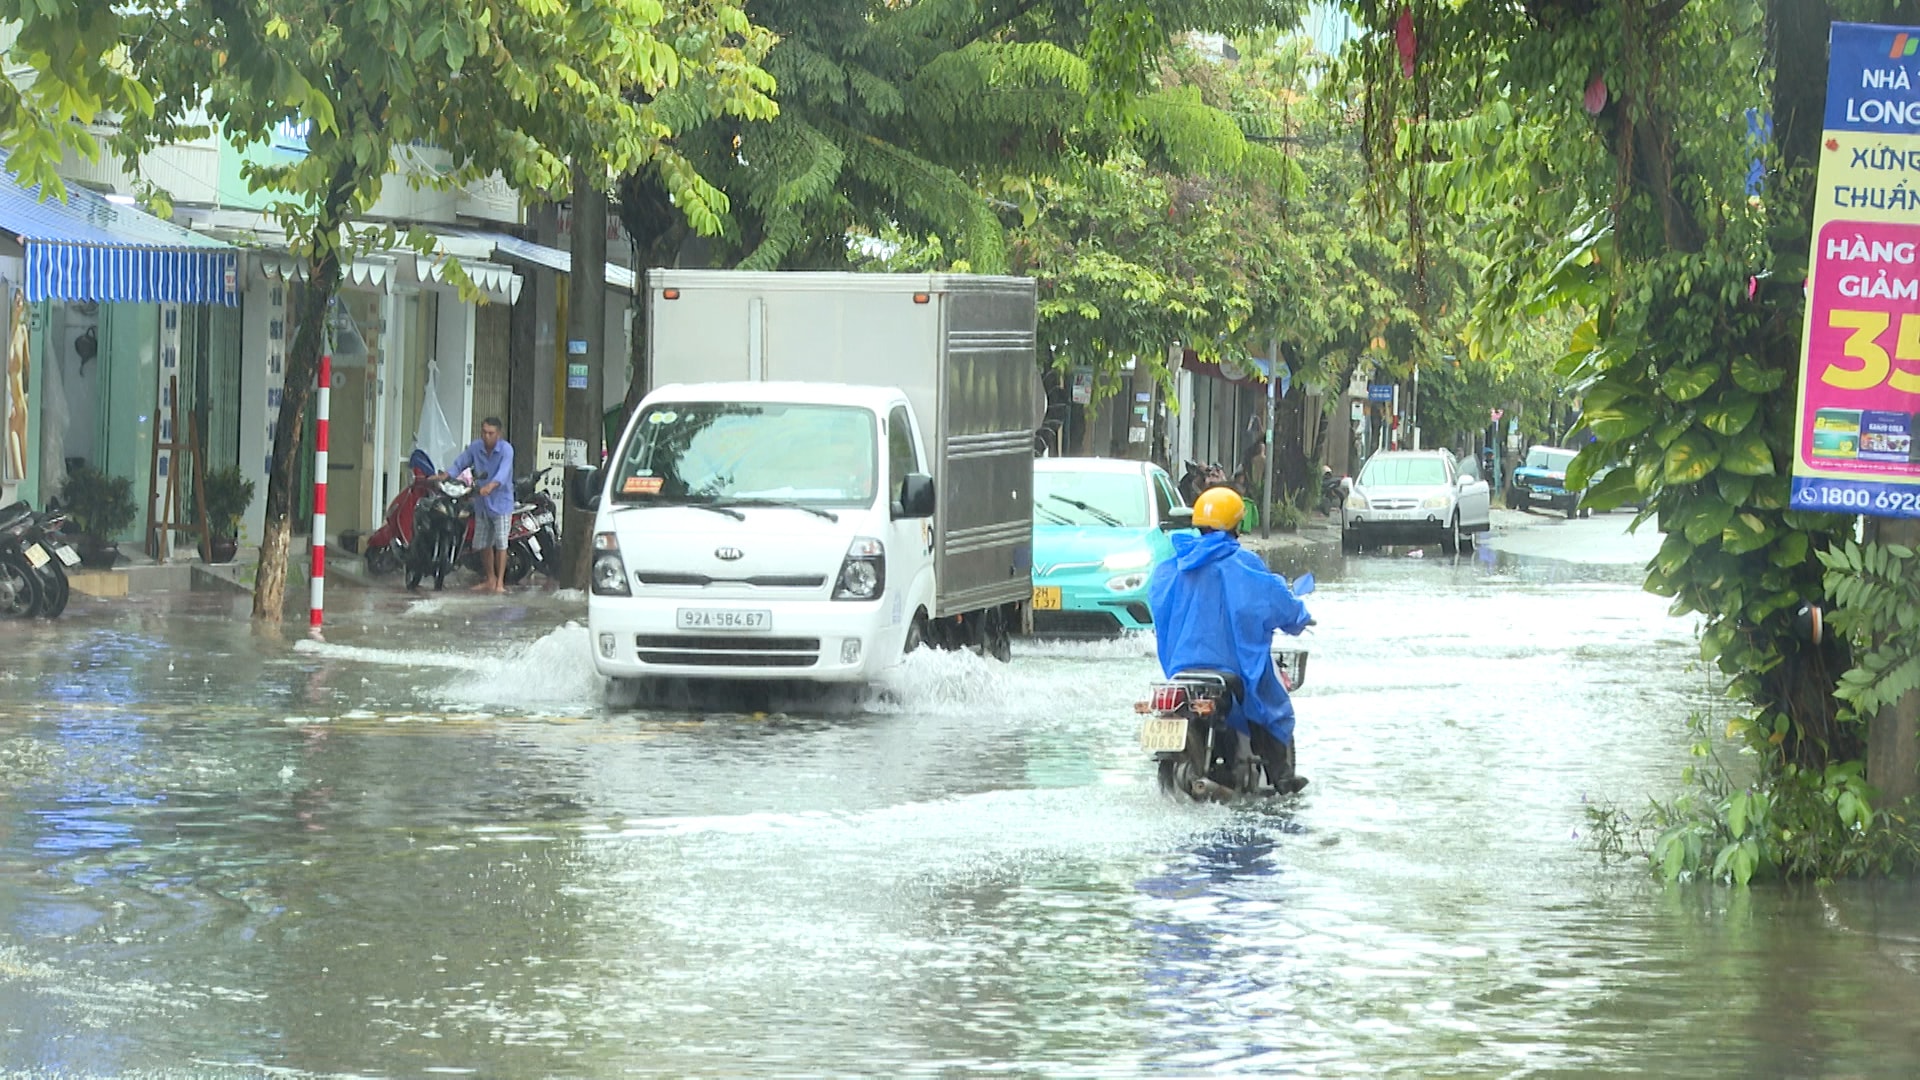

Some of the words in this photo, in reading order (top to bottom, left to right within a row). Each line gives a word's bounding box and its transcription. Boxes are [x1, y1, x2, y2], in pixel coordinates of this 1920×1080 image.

[1862, 65, 1911, 90] NHÀ
[1846, 97, 1920, 125] LONG
[1850, 142, 1920, 171] XỨNG
[1826, 233, 1915, 264] HÀNG
[1838, 269, 1918, 300] GIẢM
[1821, 487, 1870, 507] 1800
[717, 548, 741, 559] KIA
